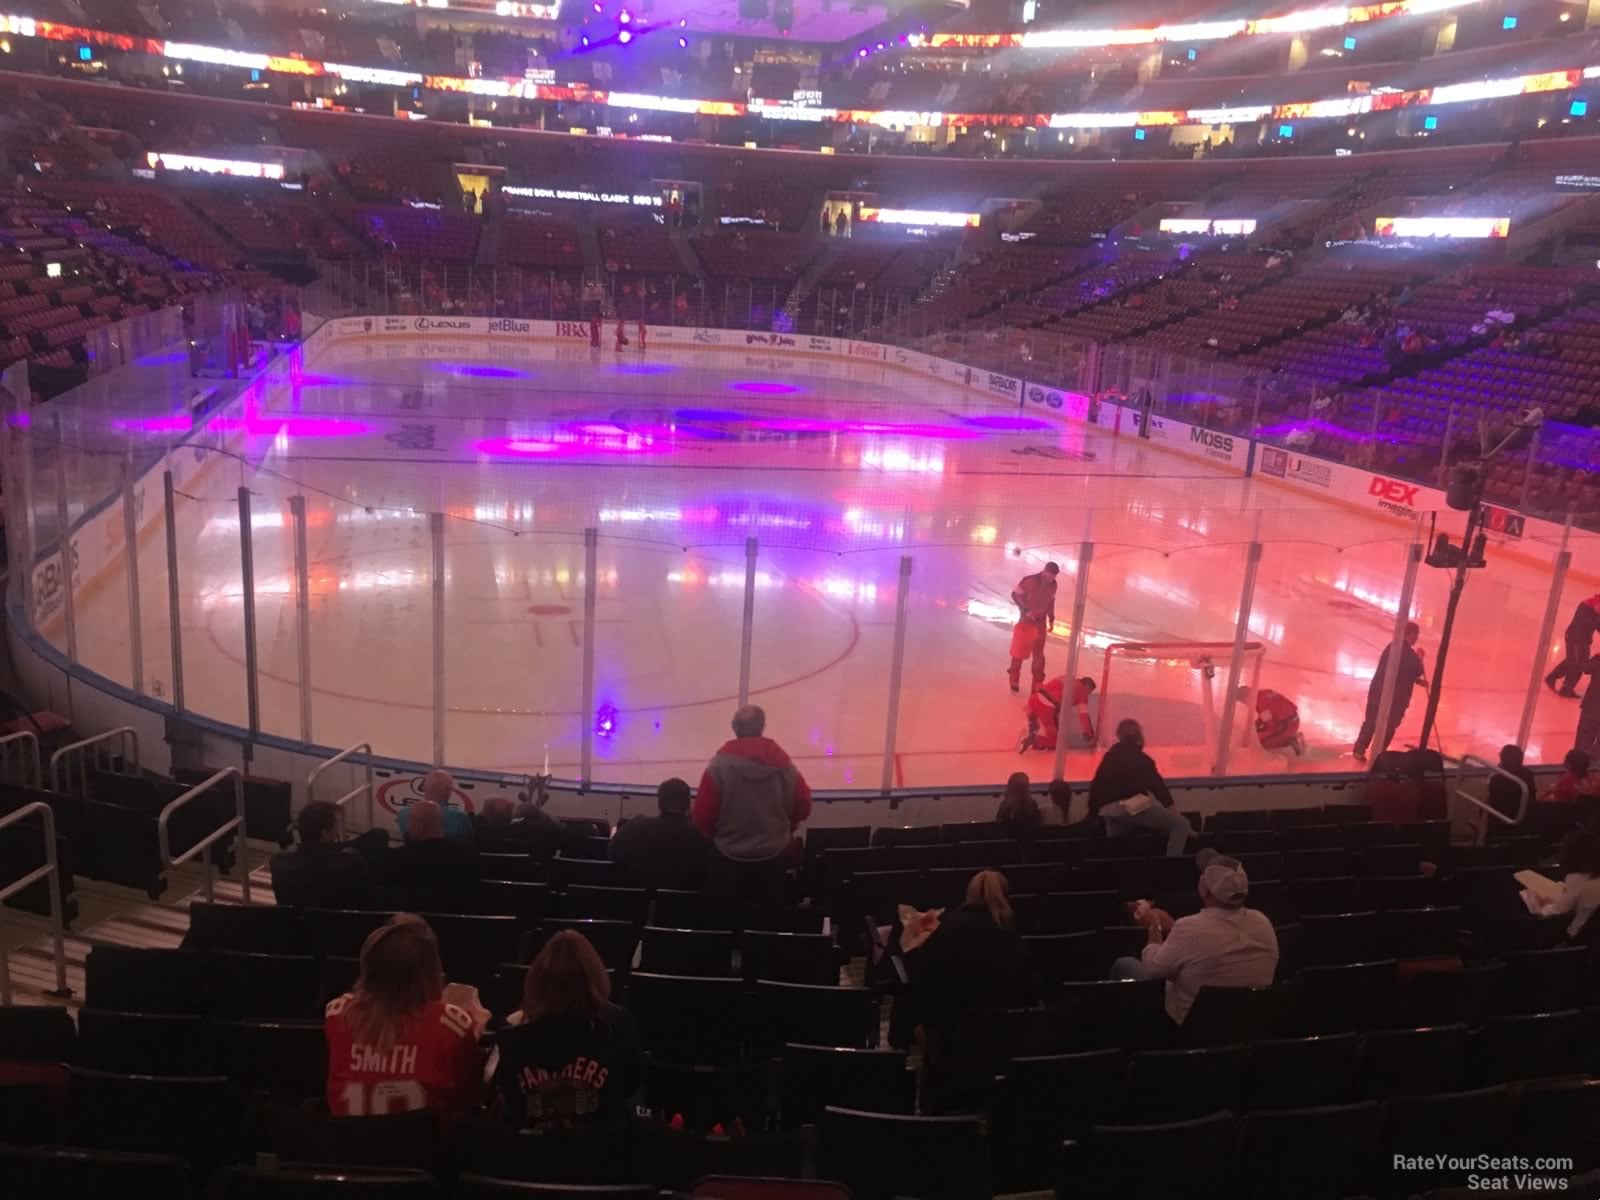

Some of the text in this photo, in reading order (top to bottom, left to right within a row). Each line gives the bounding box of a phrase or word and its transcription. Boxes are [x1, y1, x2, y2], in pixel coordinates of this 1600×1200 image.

[556, 190, 600, 201] BASKETBALL
[488, 319, 530, 333] jetBlue
[556, 322, 590, 337] BB&
[1190, 427, 1233, 452] MOSS
[1368, 476, 1419, 507] DEX
[350, 1043, 417, 1074] SMITH
